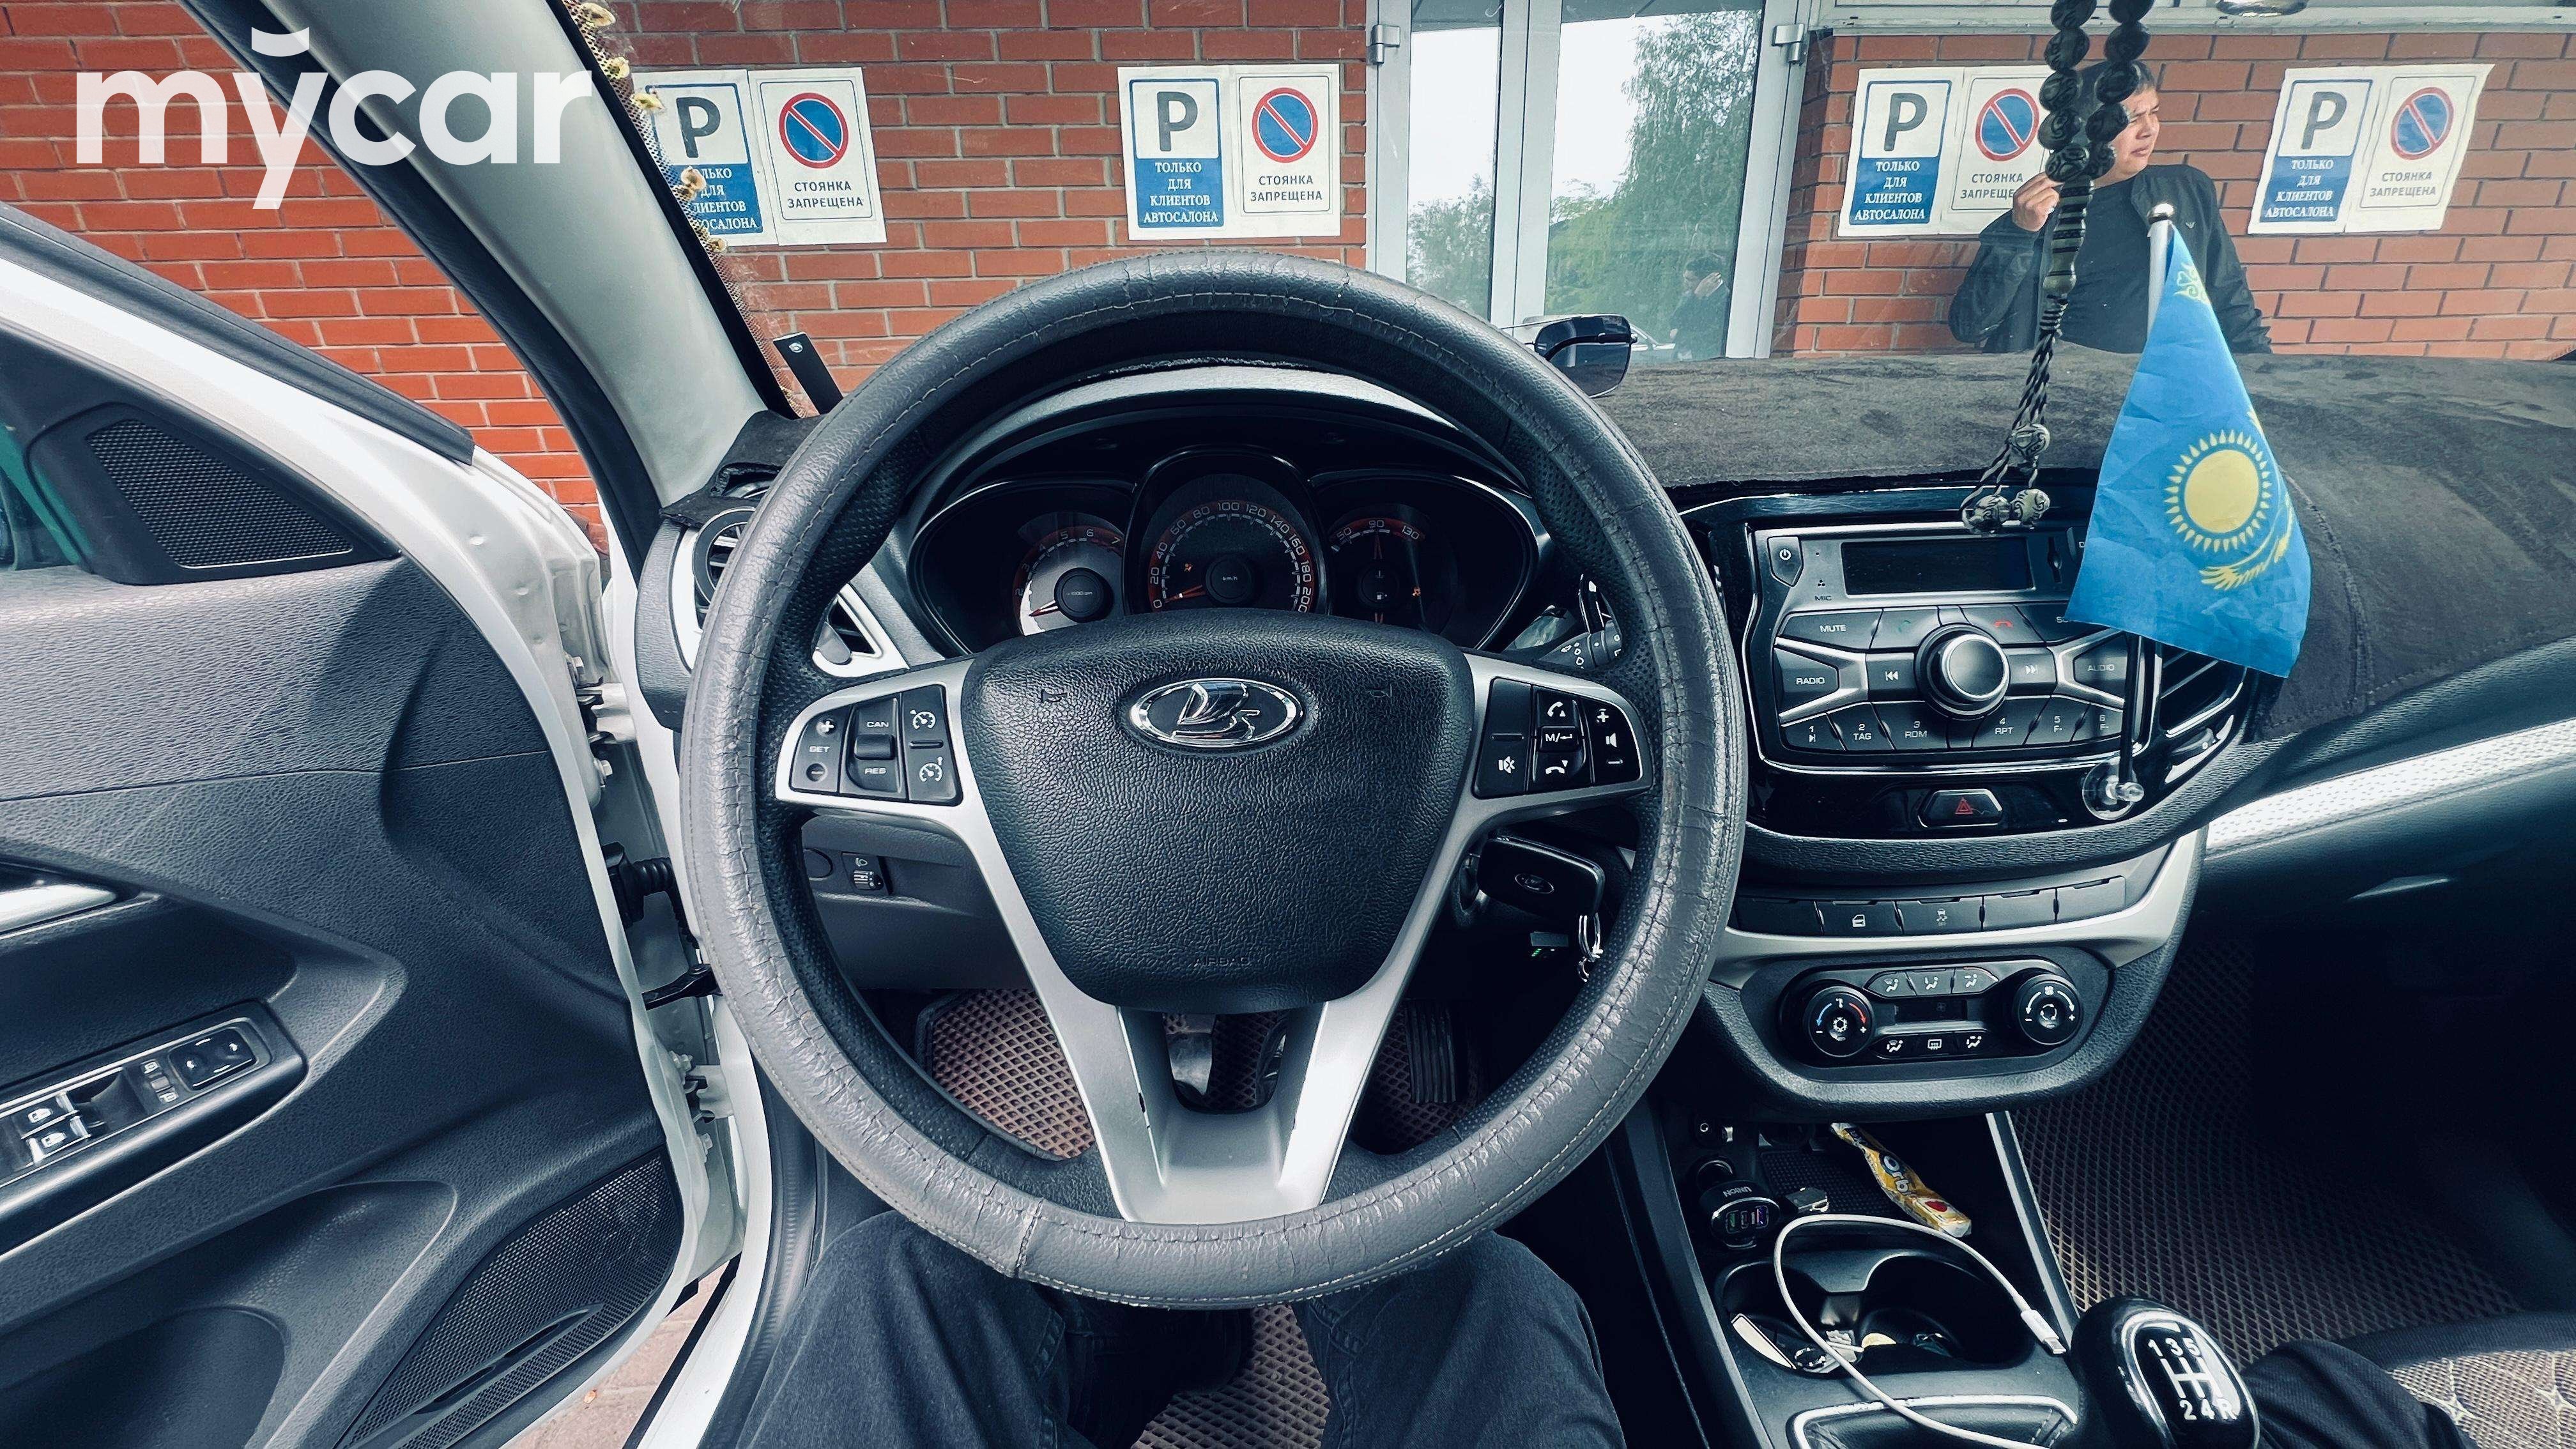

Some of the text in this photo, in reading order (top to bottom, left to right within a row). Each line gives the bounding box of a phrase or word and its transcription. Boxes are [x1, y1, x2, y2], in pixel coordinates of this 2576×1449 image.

[676, 96, 721, 158] P
[1156, 91, 1198, 152] P
[1883, 93, 1928, 151] P
[2301, 91, 2347, 150] P
[1154, 162, 1202, 174] ТОЛЬКО
[1875, 160, 1920, 172] ТОЛЬКО
[2291, 159, 2334, 170] ТОЛЬКО
[701, 167, 732, 179] ЛЬКО
[1972, 173, 2023, 183] СТОЯНКА
[2381, 171, 2432, 182] СТОЯНКА
[794, 180, 852, 192] СТОЯНКА
[1167, 178, 1192, 191] ДЛЯ
[1259, 174, 1314, 186] СТОЯНКА
[1883, 177, 1908, 190] ДЛЯ
[2296, 174, 2321, 187] ДЛЯ
[700, 185, 725, 199] ДЛЯ
[1250, 190, 1323, 203] ЗАПРЕЩЕНА
[1864, 192, 1922, 204] КЛИЕНТОВ
[1960, 188, 2014, 201] ЗАПРЕЩЕ
[2274, 190, 2333, 202] КЛИЕНТОВ
[2369, 186, 2436, 197] ЗАПРЕЩЕНА
[787, 197, 864, 210] ЗАПРЕЩЕНА
[1149, 195, 1211, 207] КЛИЕНТОВ
[1143, 211, 1219, 224] АВТОСАЛОНА
[1854, 209, 1926, 221] АВТОСАЛОНА
[2264, 206, 2335, 218] АВТОСАЛОНА
[700, 217, 758, 230] ОСАЛОНА
[1192, 506, 1211, 519] 80
[1218, 502, 1240, 511] 100
[1245, 503, 1267, 518] 120
[1170, 519, 1186, 535] 60
[1270, 514, 1290, 534] 140
[1368, 519, 1384, 528] 90
[1060, 530, 1069, 540] 5
[1086, 528, 1094, 537] 6
[1402, 525, 1420, 540] 130
[1156, 542, 1168, 560] 40
[1289, 533, 1305, 556] 160
[1150, 567, 1160, 585] 20
[1300, 560, 1312, 583] 180
[1153, 599, 1162, 608] 0
[1298, 586, 1312, 613] 200
[1820, 624, 1846, 632] MUTE
[1913, 721, 1920, 729] 3
[1995, 726, 2014, 735] RPT
[2147, 1337, 2200, 1357] 1 3 5
[2179, 1398, 2237, 1420] 2 4 R
